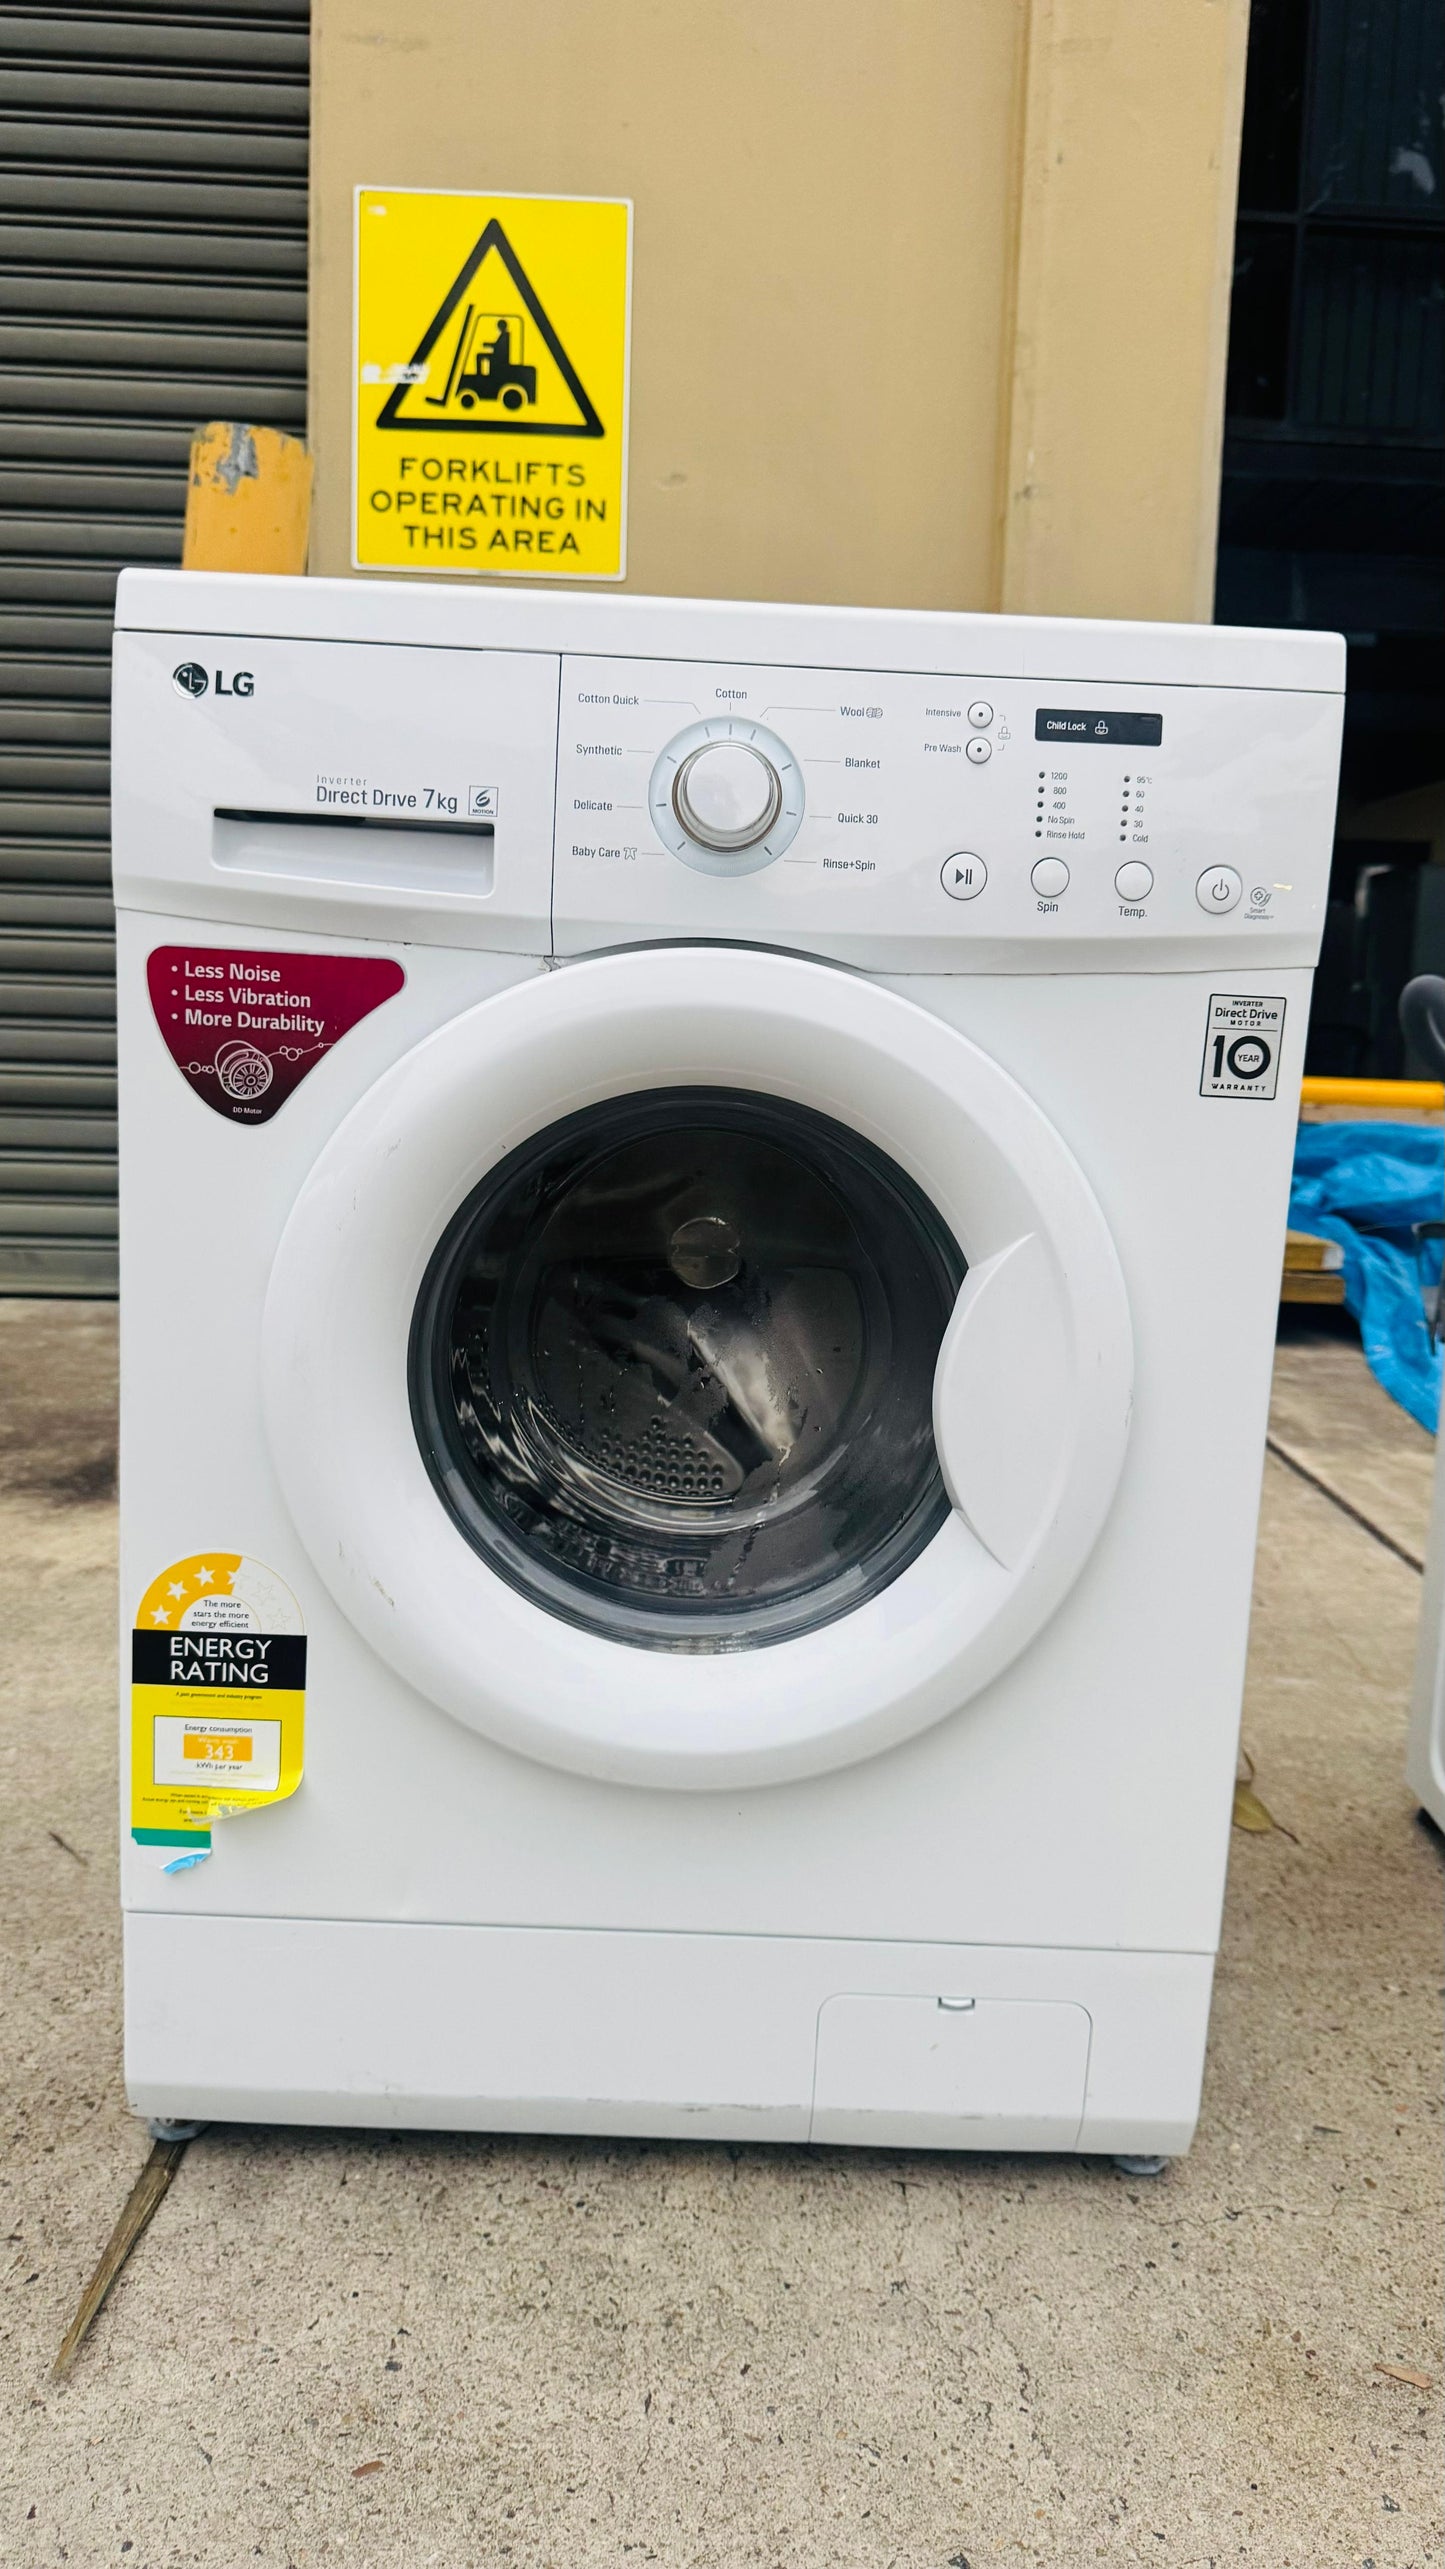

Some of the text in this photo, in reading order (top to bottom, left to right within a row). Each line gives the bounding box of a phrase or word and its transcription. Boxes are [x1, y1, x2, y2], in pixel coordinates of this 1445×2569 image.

[400, 457, 586, 487] FORKLIFTS
[371, 489, 607, 522] OPERATING IN
[403, 525, 581, 555] THIS AREA
[215, 669, 255, 697] LG
[578, 693, 640, 706] Cotton Quick
[715, 688, 748, 700] Cotton
[840, 706, 865, 718] Wool
[925, 707, 962, 718] Intensive
[1046, 720, 1087, 732] Child Lock
[576, 744, 623, 757] Synthetic
[924, 743, 962, 754] Pre Wash
[845, 757, 881, 769] Blanket
[316, 774, 368, 786] Inverter
[1051, 771, 1068, 781] 1200
[316, 786, 368, 805] Direct
[373, 789, 418, 808] Drive
[1053, 787, 1067, 795] 800
[1136, 790, 1145, 798] 60
[573, 800, 613, 812] Delicate
[1052, 801, 1066, 810] 400
[1134, 805, 1144, 813] 40
[472, 808, 494, 816] MOTION
[837, 813, 879, 825] Quick 30
[1047, 815, 1075, 826] No Spin
[1133, 820, 1143, 828] 30
[1046, 830, 1085, 840] Rinse Hold
[1132, 834, 1149, 843] Cold
[572, 846, 621, 859] Baby Care
[823, 858, 877, 872] Rinse+Spin
[1036, 901, 1059, 914] Spin
[1118, 905, 1148, 919] Temp.
[185, 960, 281, 983] Less Noise
[185, 984, 311, 1008] Less Vibration
[1215, 1007, 1278, 1020] Direct Drive
[185, 1008, 325, 1037] More Durability
[1212, 1034, 1271, 1080] 10
[1238, 1054, 1260, 1063] YEAR
[1211, 1083, 1266, 1092] WARRANTY
[233, 1106, 262, 1115] DD Motor
[203, 1599, 218, 1608] The
[214, 1610, 225, 1618] the
[191, 1620, 249, 1629] energy efficient
[170, 1636, 273, 1660] ENERGY
[170, 1660, 269, 1684] RATING
[184, 1723, 253, 1734] Energy consumption
[205, 1743, 234, 1760] 343
